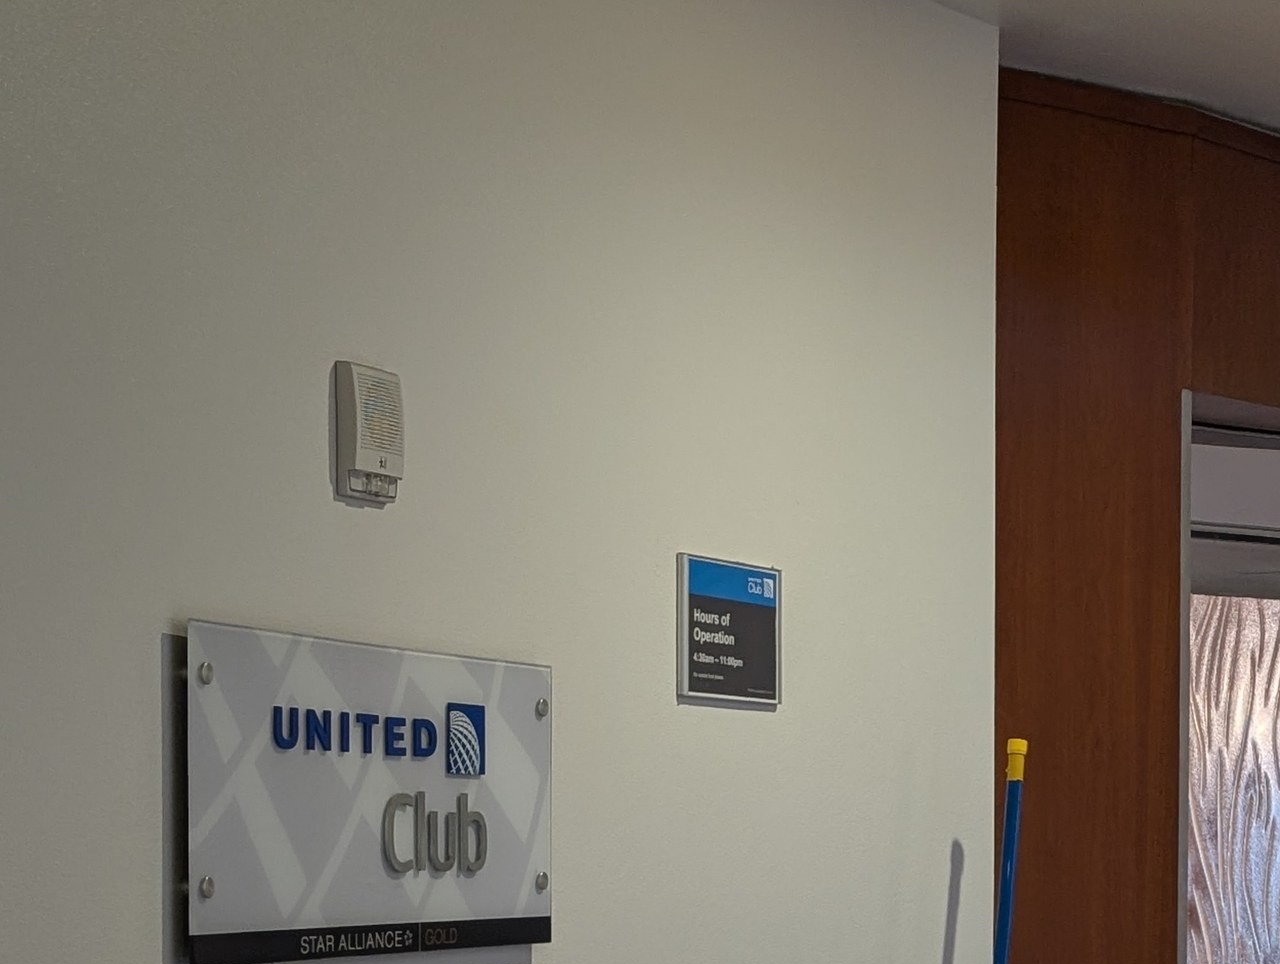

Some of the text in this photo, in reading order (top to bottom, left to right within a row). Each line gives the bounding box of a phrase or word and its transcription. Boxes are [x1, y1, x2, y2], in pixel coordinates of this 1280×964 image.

[693, 608, 731, 627] Hours of
[693, 627, 735, 646] Operation
[272, 705, 438, 758] UNITED
[382, 790, 488, 874] Club
[300, 927, 458, 955] STAR ALLIANCE GOLD
